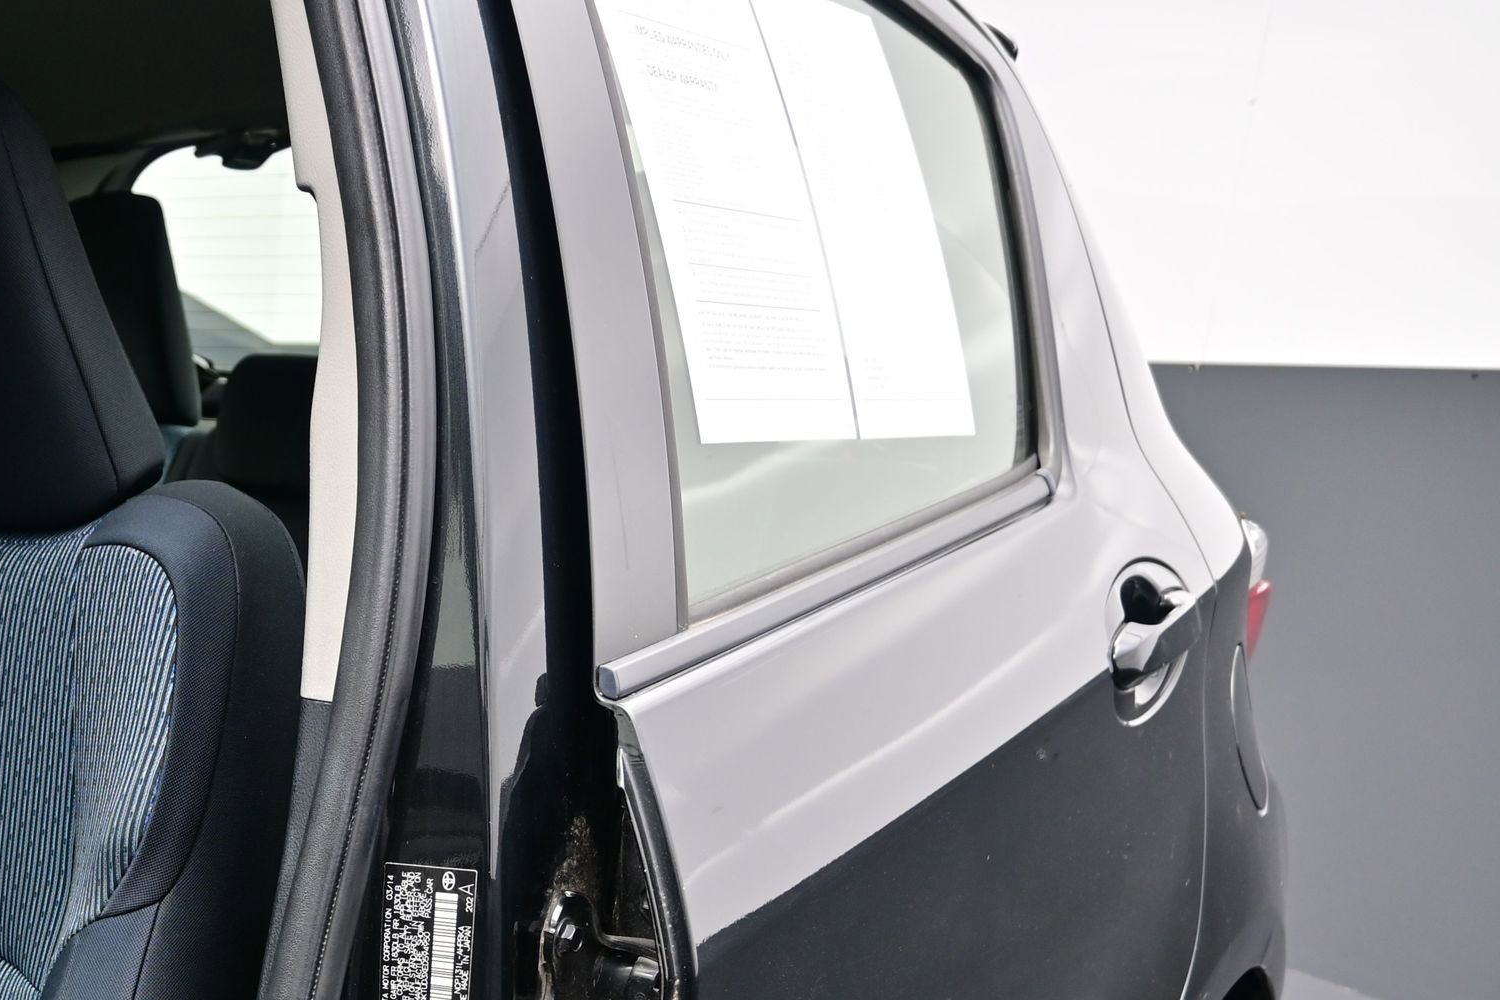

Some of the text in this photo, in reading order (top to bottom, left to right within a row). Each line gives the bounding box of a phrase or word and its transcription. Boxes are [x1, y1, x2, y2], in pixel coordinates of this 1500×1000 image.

[414, 871, 421, 883] ON
[457, 881, 474, 896] A
[399, 870, 408, 920] APPLICABLE
[411, 886, 420, 917] EFFECT
[465, 896, 473, 912] 202
[383, 907, 392, 961] CORPORATION
[392, 918, 399, 929] RR
[417, 920, 425, 946] SHOWN
[398, 942, 405, 953] TO
[462, 925, 471, 951] JAPAN
[409, 934, 418, 978] STANDARDS
[462, 954, 469, 965] IN
[382, 963, 390, 989] MOTOR
[391, 965, 397, 976] FR
[396, 956, 404, 996] CONFORMS
[402, 957, 410, 991] VEHICLE
[460, 969, 468, 990] MADE
